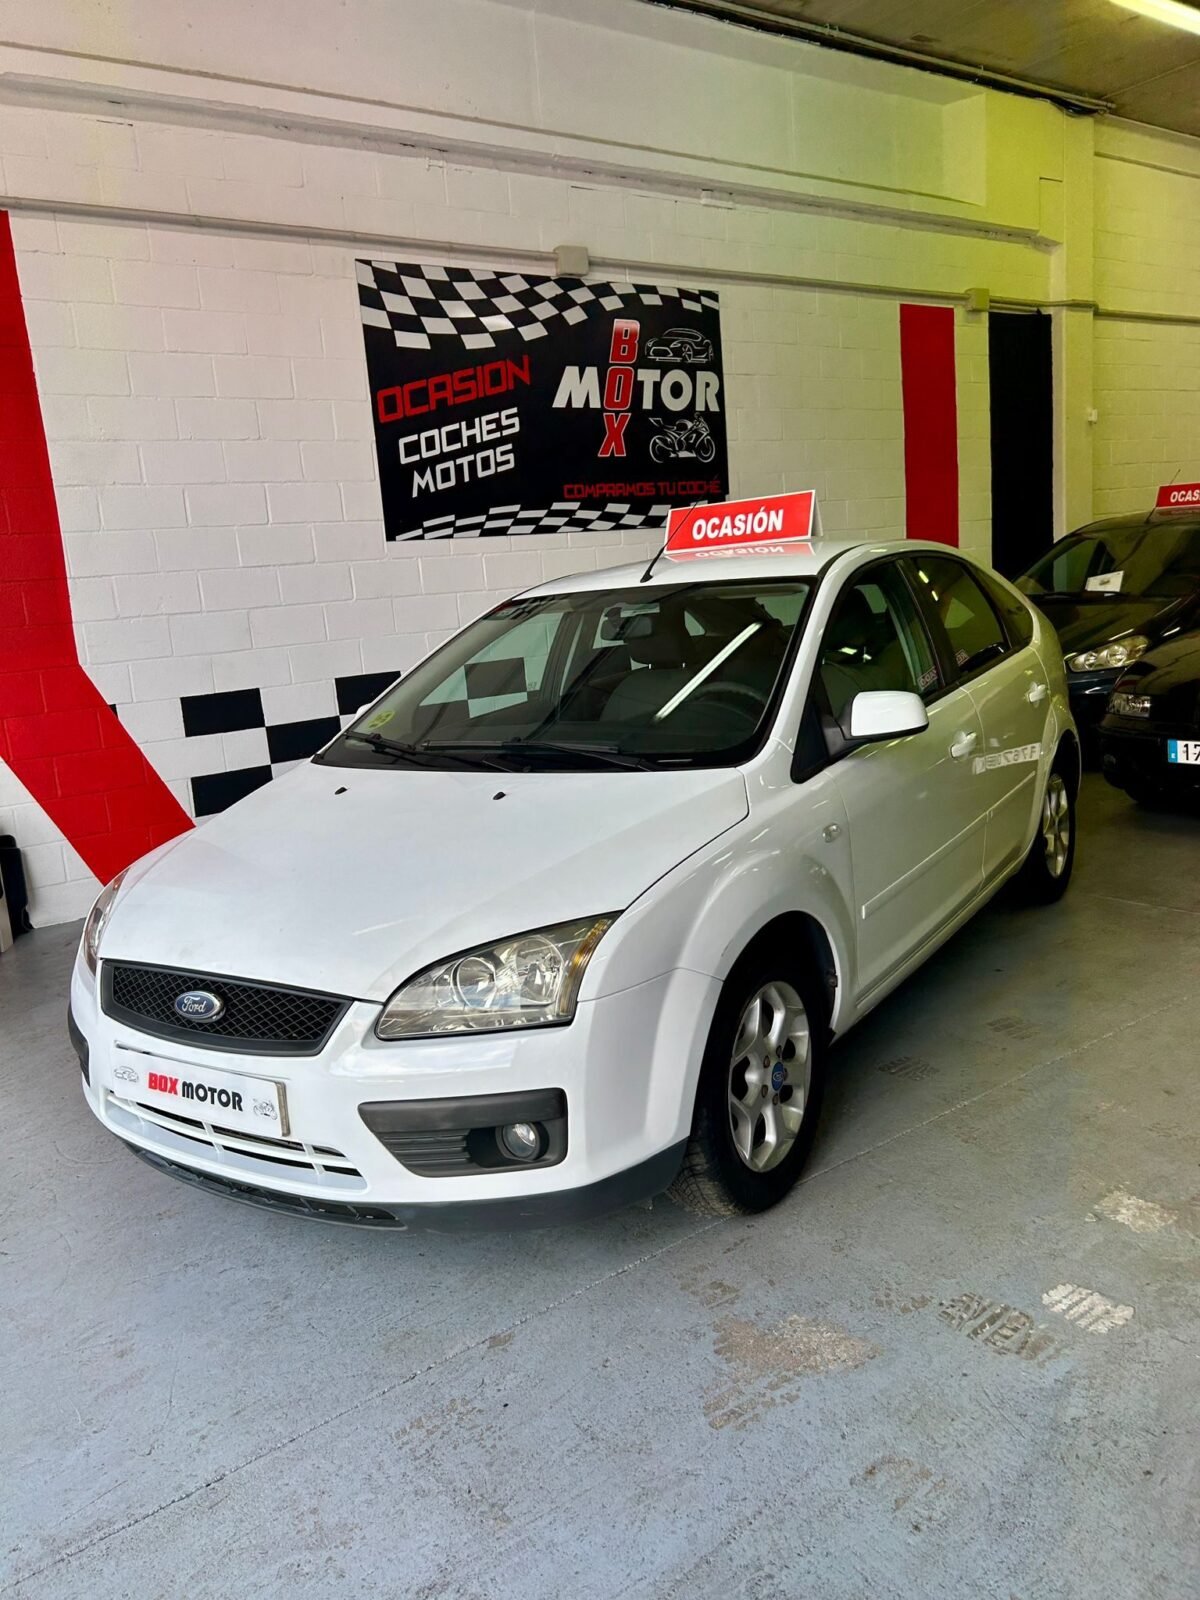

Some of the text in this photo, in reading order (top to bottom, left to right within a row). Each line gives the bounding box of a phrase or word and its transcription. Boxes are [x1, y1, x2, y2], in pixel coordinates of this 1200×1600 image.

[376, 355, 531, 424] OCASION
[598, 318, 641, 457] BOX
[398, 407, 520, 465] COCHES
[411, 443, 515, 498] MOTOS
[563, 483, 656, 499] COMPRAMOS
[657, 482, 676, 496] TU
[1170, 489, 1200, 503] OCAS
[692, 506, 784, 540] OCASIÓN
[181, 996, 207, 1013] Ford
[148, 1072, 243, 1112] BOX MOTOR
